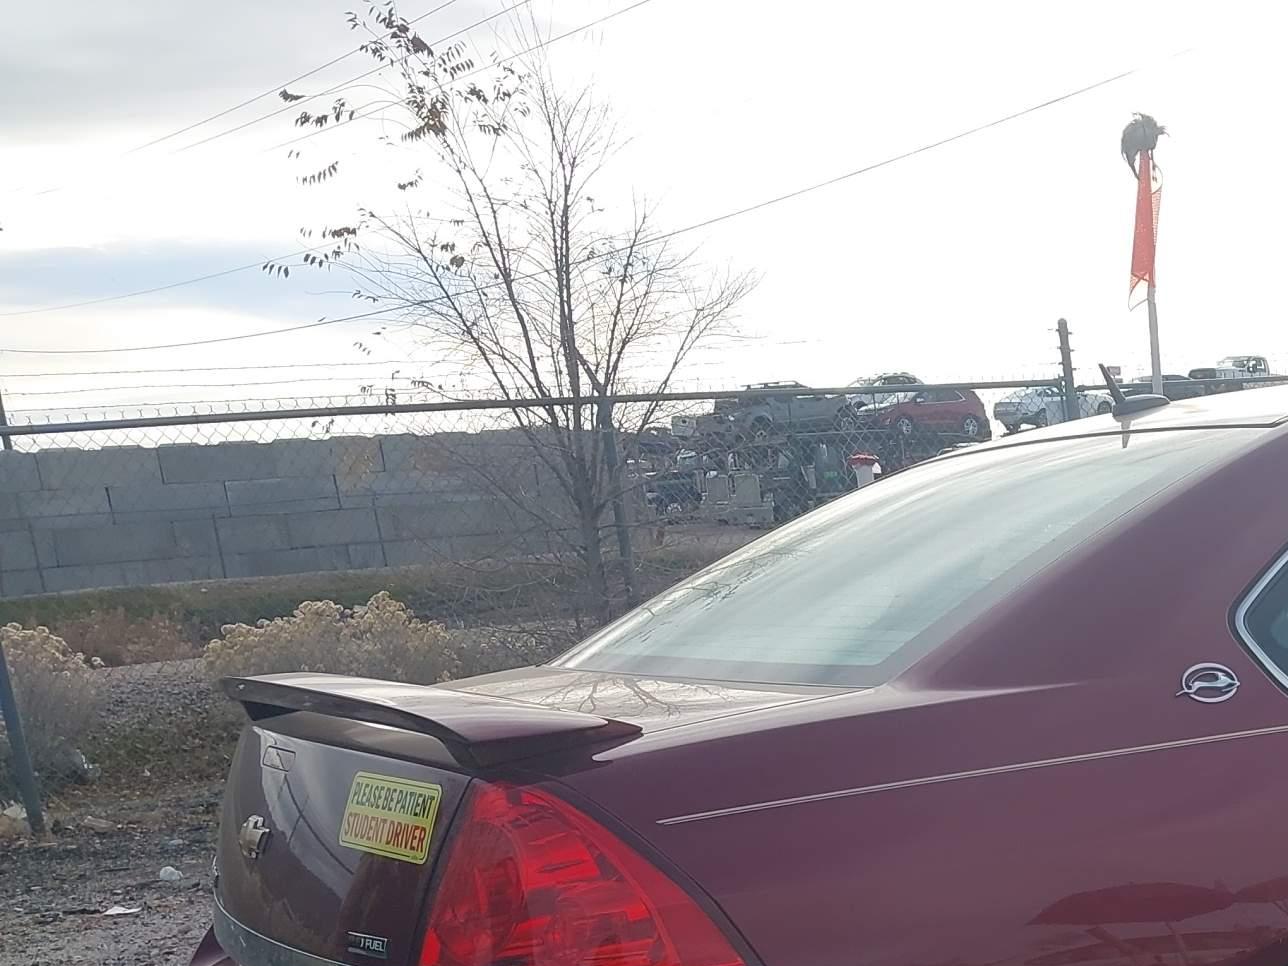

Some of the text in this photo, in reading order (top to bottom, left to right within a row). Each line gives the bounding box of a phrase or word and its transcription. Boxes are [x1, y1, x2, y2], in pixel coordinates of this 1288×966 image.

[352, 781, 435, 819] PLEASE BE PATIENT
[344, 812, 427, 853] STUDENT DRIVER
[365, 939, 385, 952] FUEL
